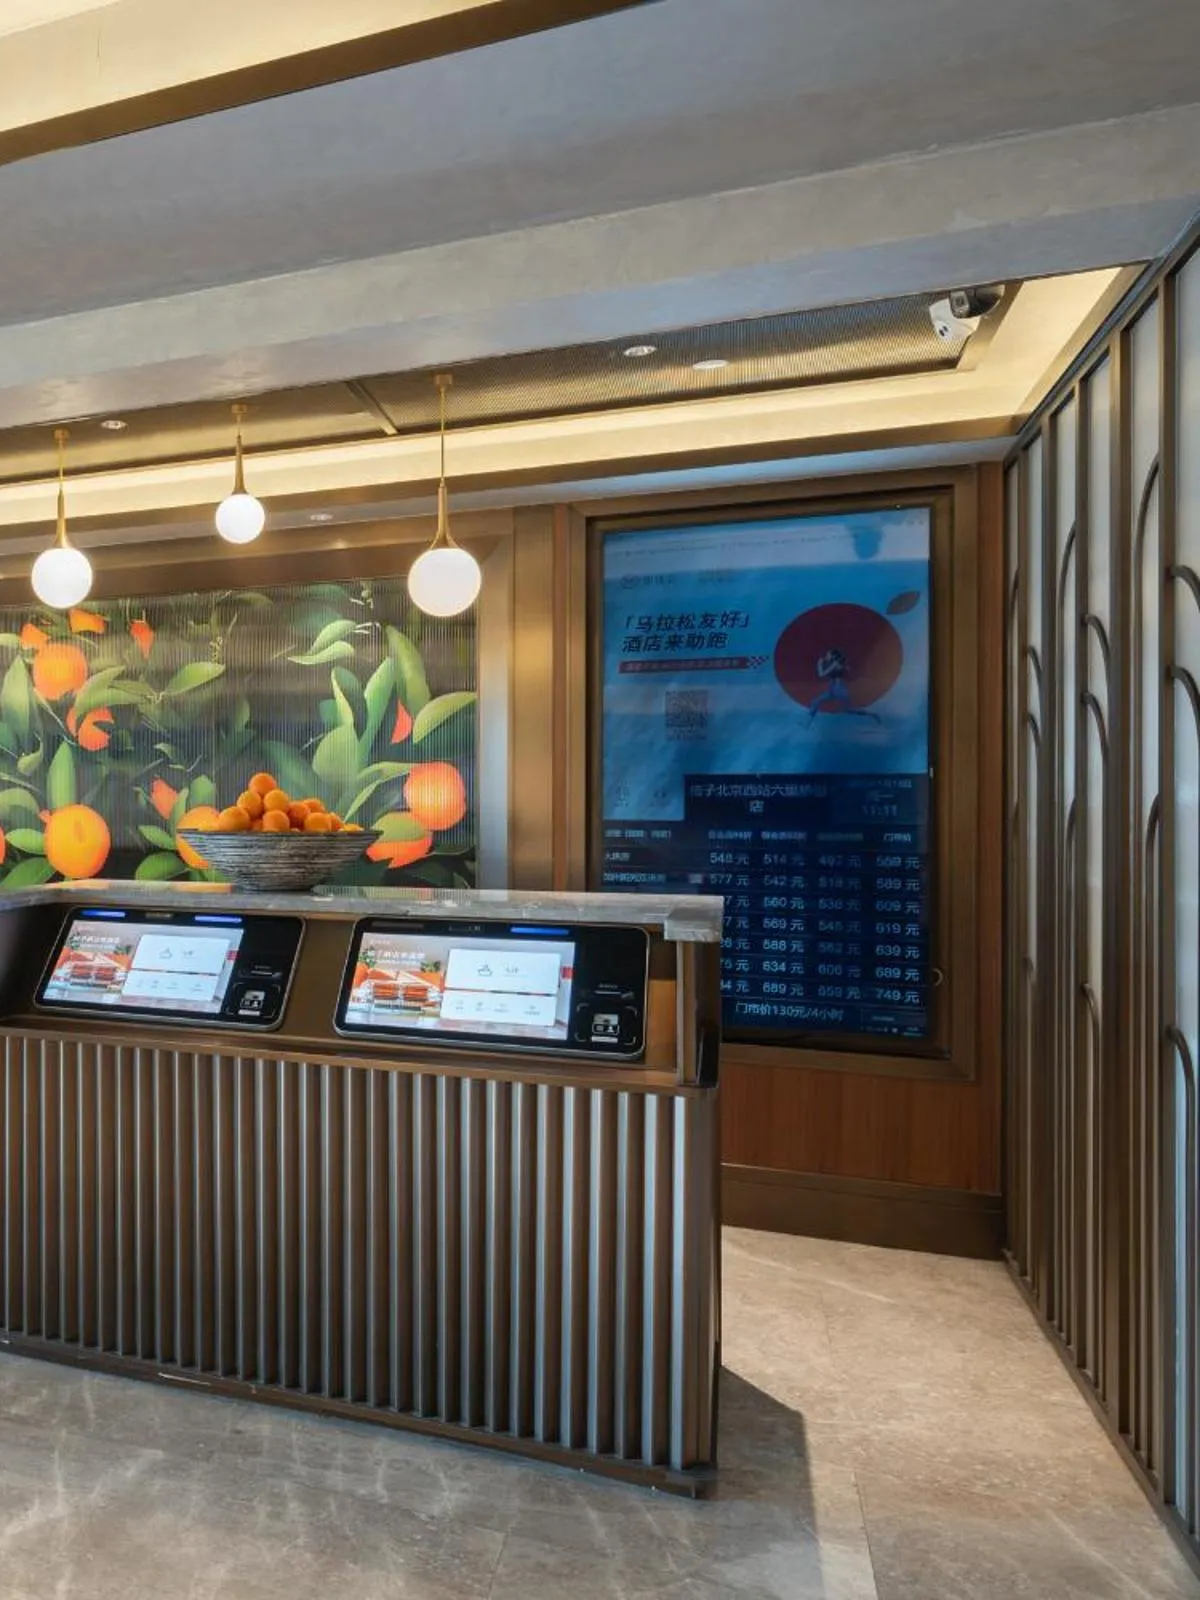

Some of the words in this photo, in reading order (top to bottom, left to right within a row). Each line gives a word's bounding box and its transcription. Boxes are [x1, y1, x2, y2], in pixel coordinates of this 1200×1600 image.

[622, 632, 730, 652] 酒店来助跑
